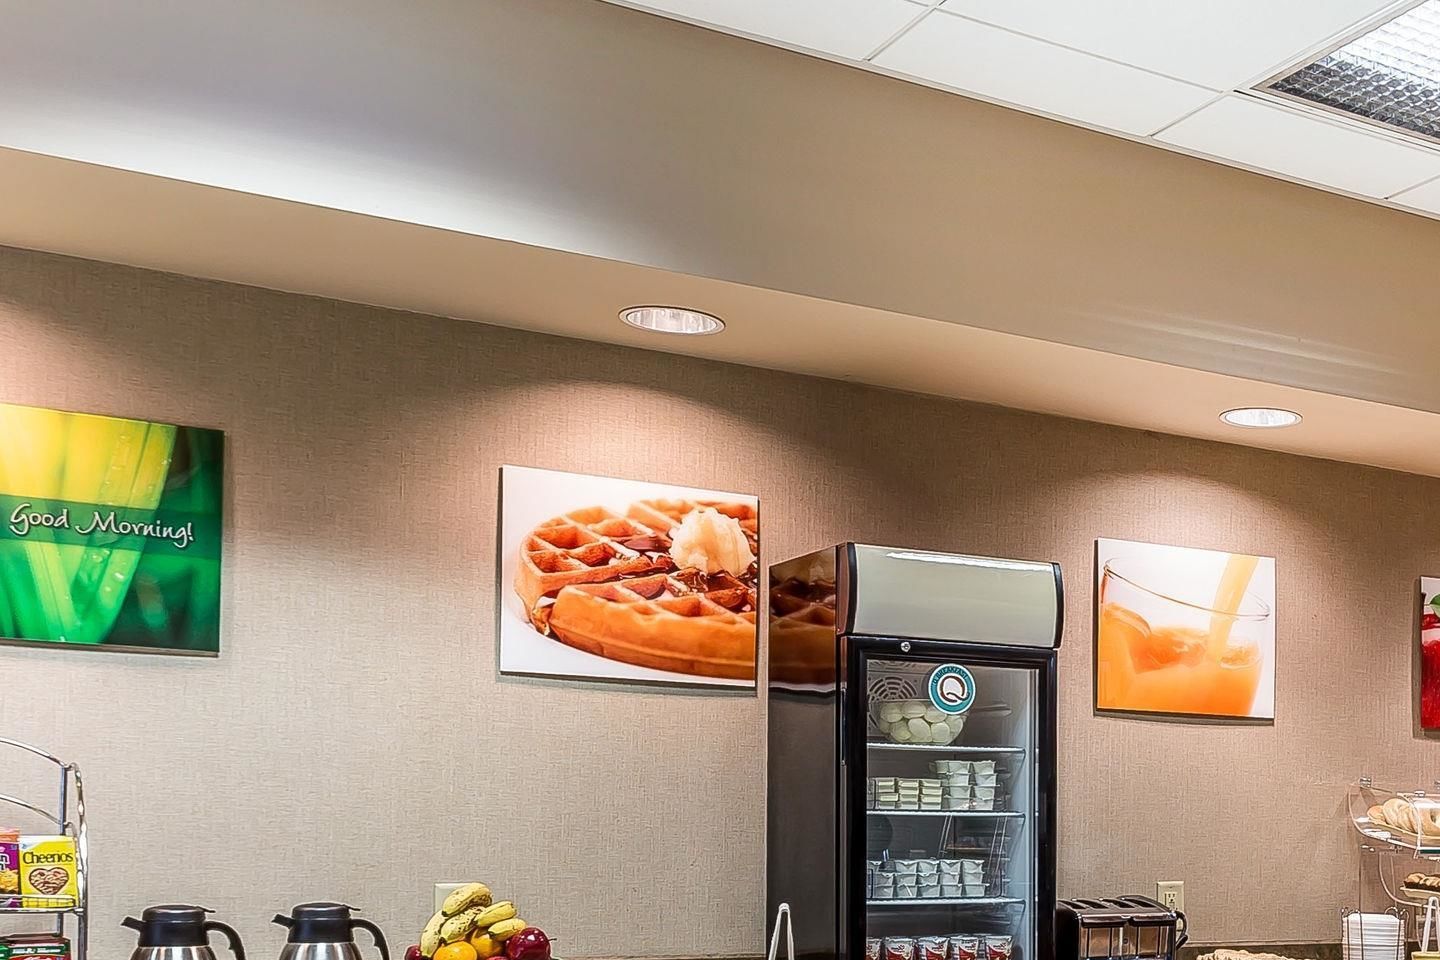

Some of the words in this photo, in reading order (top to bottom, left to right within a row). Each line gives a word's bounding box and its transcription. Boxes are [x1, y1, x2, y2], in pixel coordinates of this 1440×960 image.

[10, 503, 69, 535] Good
[75, 511, 195, 548] Morning!
[23, 851, 74, 864] Cheerios
